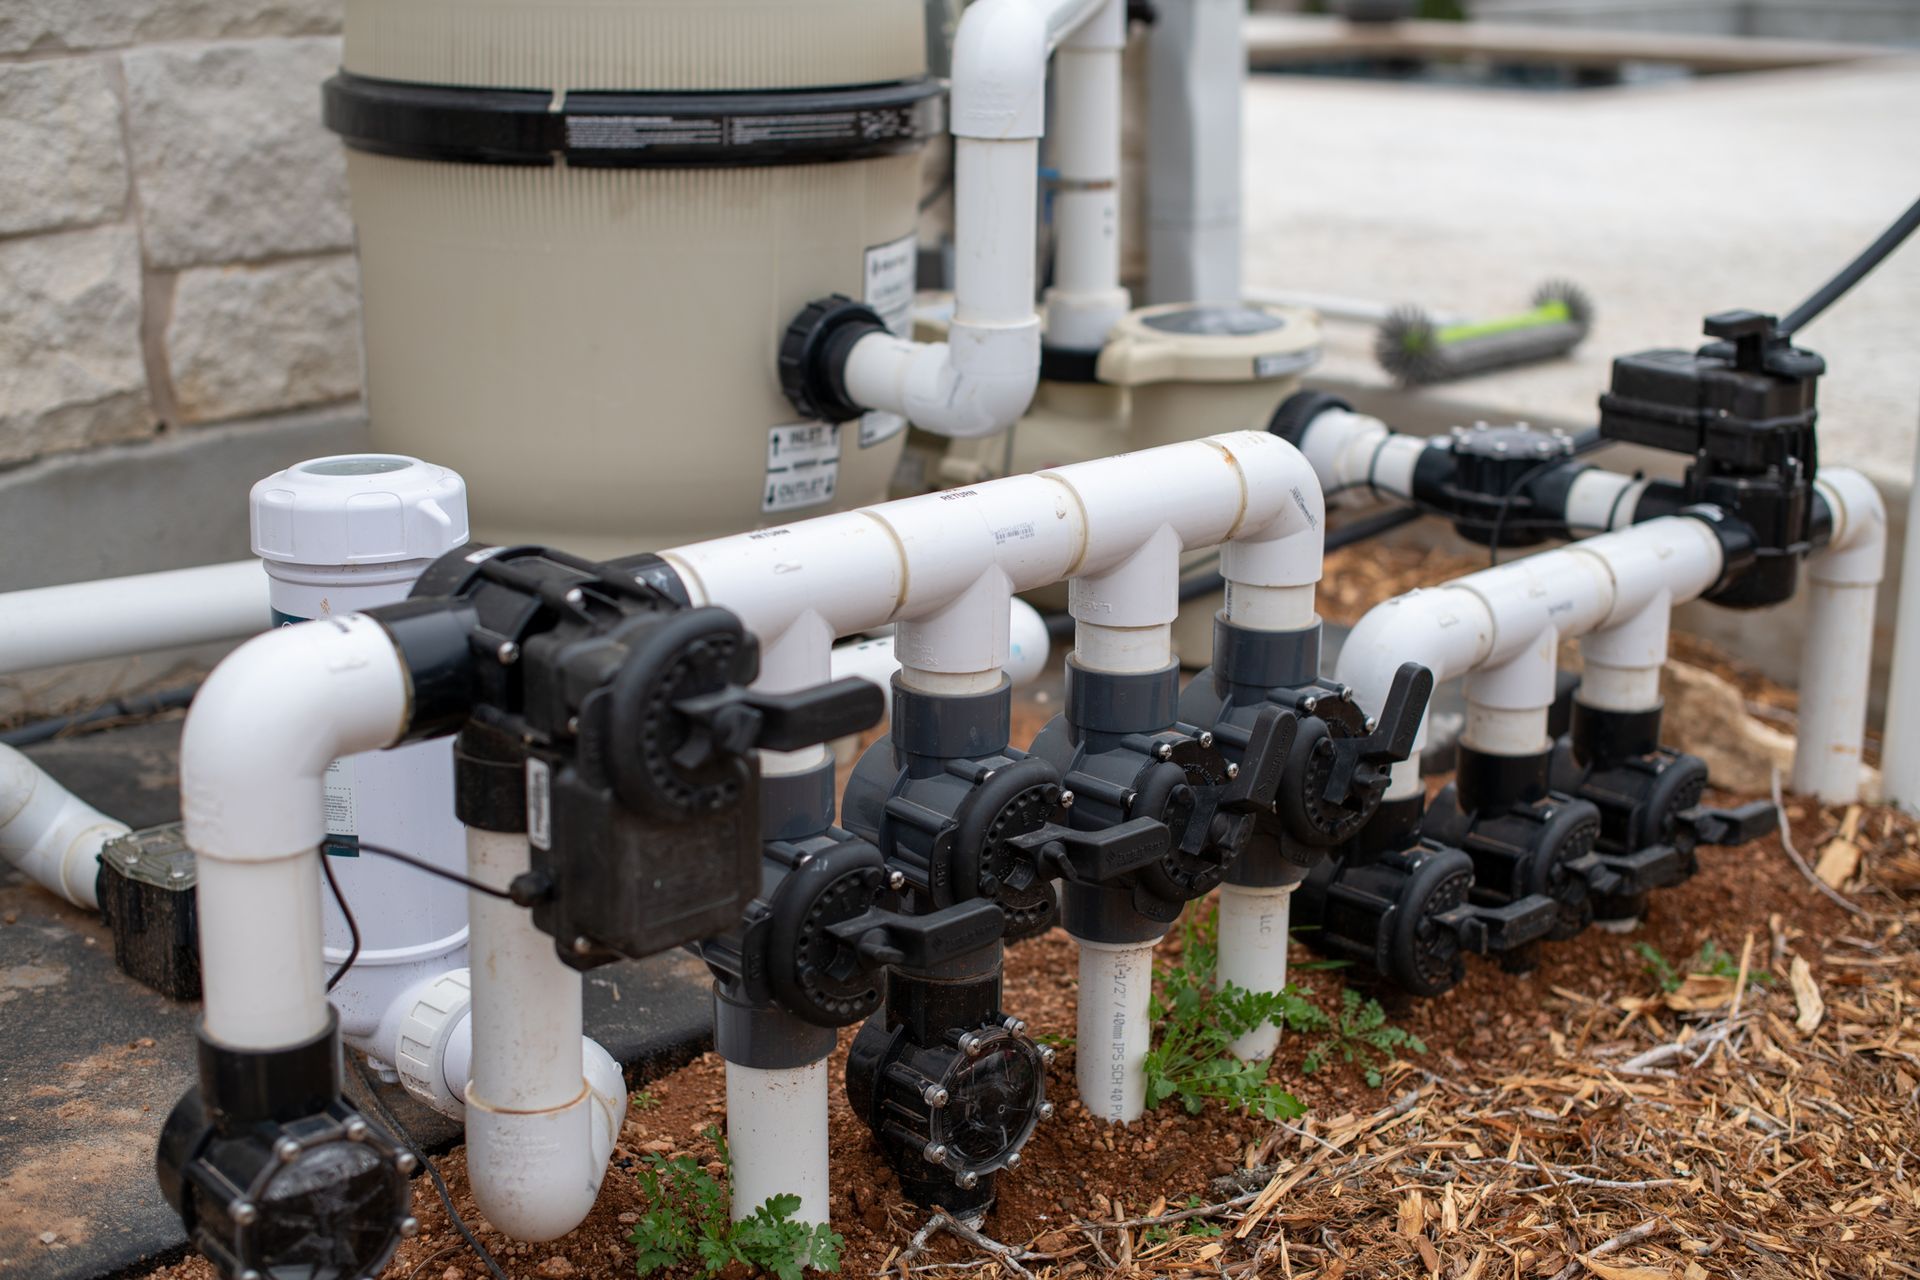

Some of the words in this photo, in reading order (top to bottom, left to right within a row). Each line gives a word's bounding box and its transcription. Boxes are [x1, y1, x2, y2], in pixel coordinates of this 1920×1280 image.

[790, 427, 823, 444] INLET
[777, 478, 825, 498] OUTLET
[940, 490, 979, 501] RETURN
[1259, 914, 1273, 934] LLC
[1112, 1011, 1126, 1040] 40mm
[1111, 1042, 1125, 1061] IPS
[1111, 1063, 1124, 1085] SCH
[1110, 1087, 1124, 1102] 40
